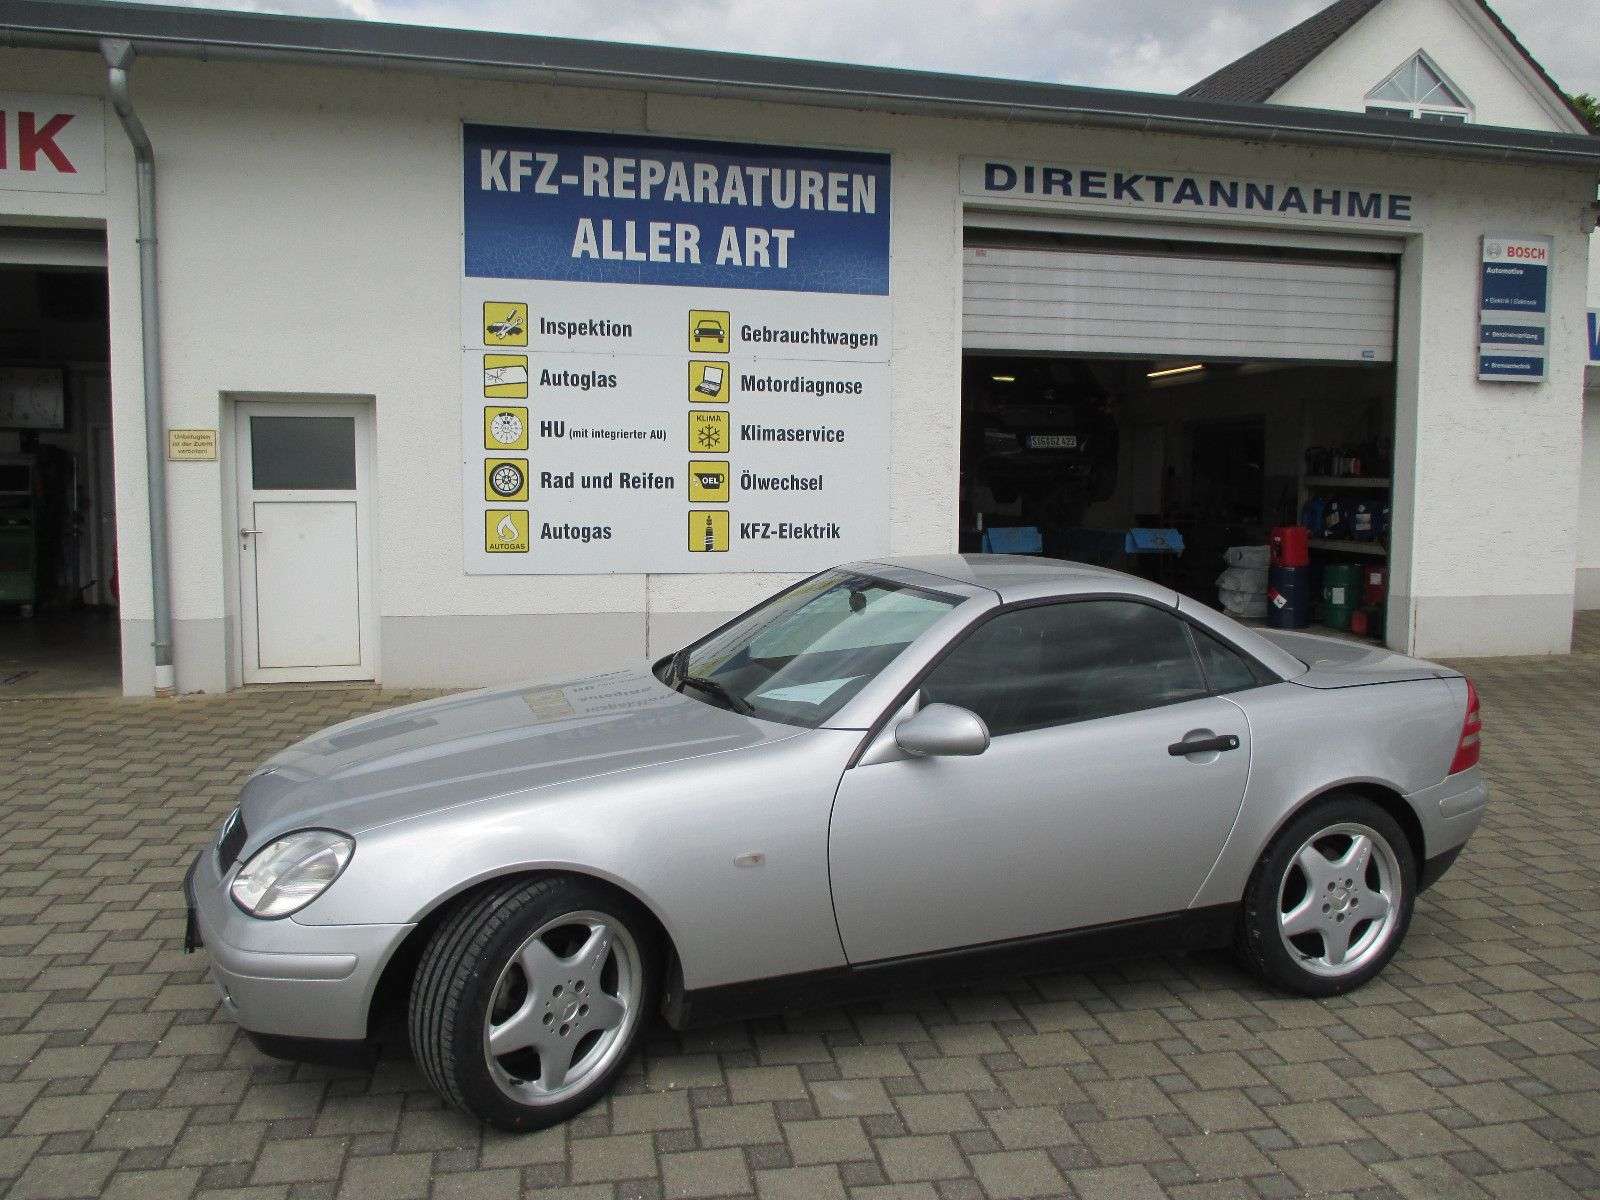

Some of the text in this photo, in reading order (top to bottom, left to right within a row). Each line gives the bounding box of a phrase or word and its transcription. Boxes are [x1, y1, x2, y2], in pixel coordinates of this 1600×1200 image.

[480, 148, 877, 215] KFZ-REPARATUREN
[983, 162, 1413, 222] DIREKTANNAHME
[570, 217, 796, 270] ALLER ART
[1506, 245, 1546, 260] BOSCH
[540, 317, 633, 339] Inspektion
[740, 324, 879, 350] Gebrauchtwagen
[539, 368, 618, 391] Autoglas
[740, 374, 863, 397] Motordiagnose
[540, 420, 667, 441] HU (mit integrierter AU)
[740, 424, 845, 443] Klimaservice
[540, 472, 675, 490] Rad und Reifen
[740, 470, 823, 491] Ölwechsel
[540, 523, 612, 543] Autogas
[740, 523, 841, 540] KFZ-Elektrik
